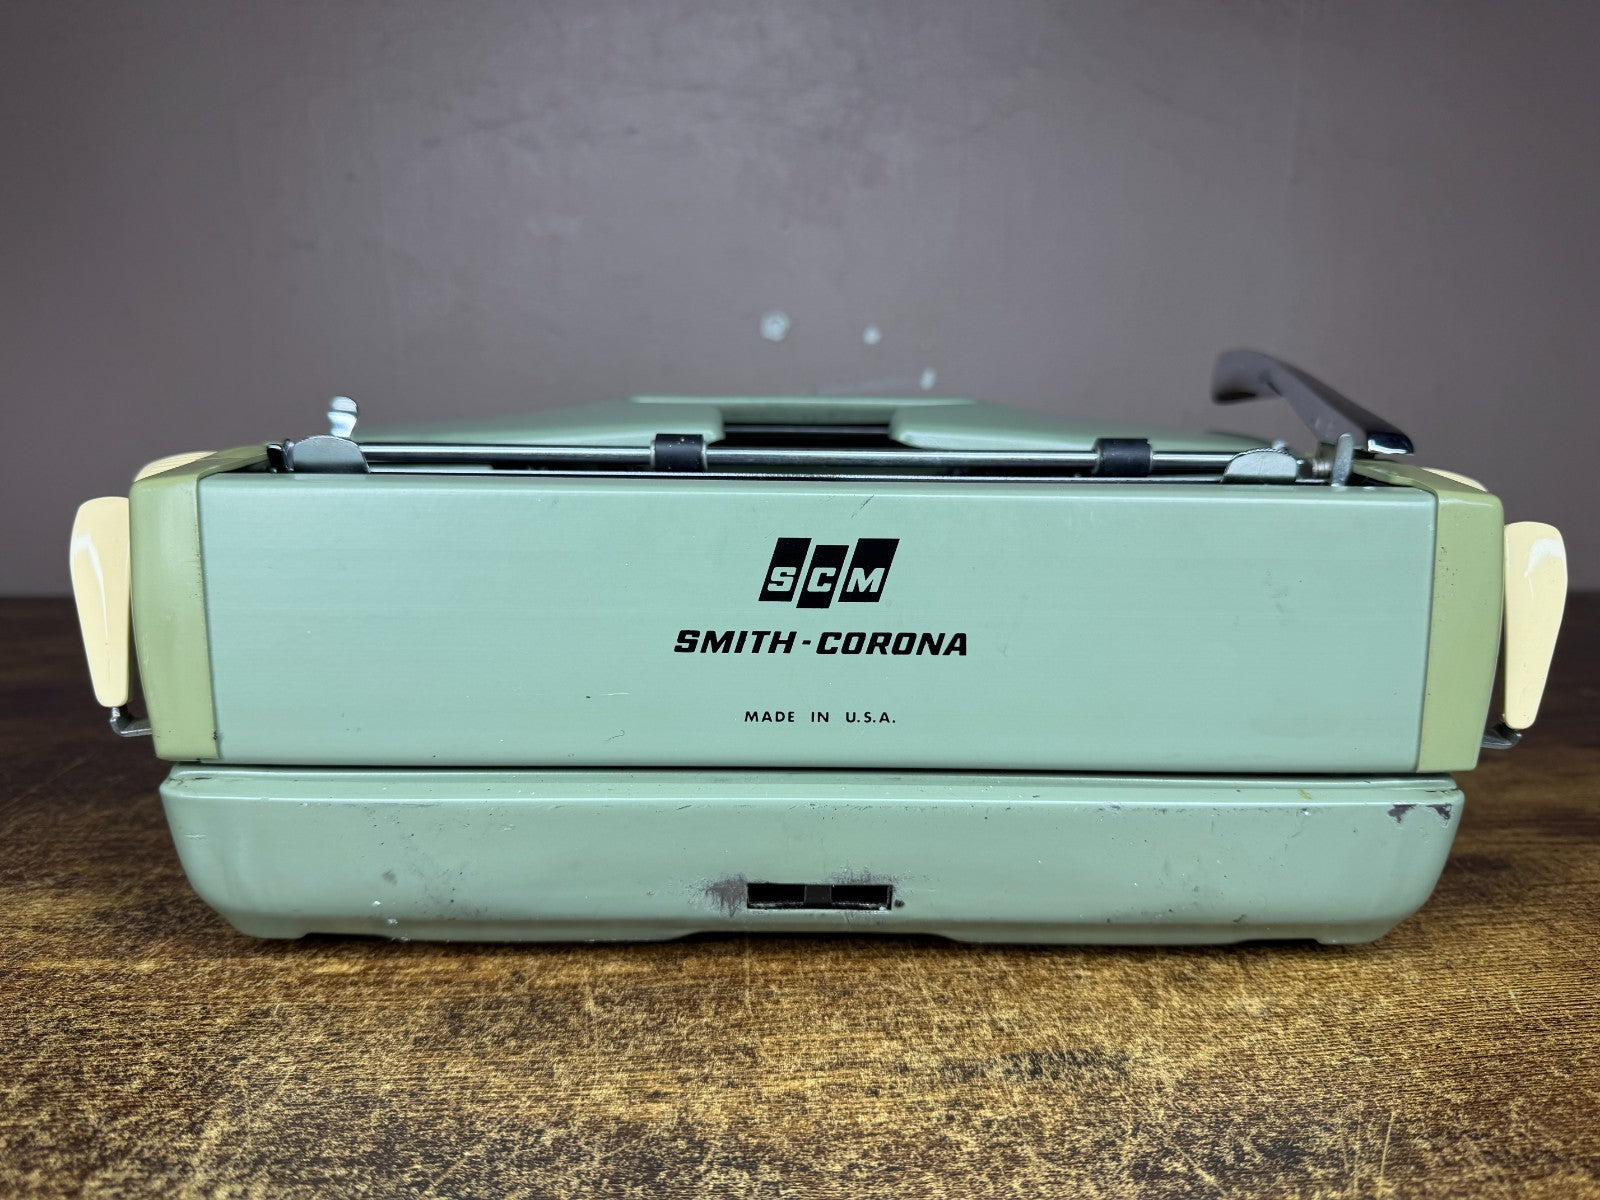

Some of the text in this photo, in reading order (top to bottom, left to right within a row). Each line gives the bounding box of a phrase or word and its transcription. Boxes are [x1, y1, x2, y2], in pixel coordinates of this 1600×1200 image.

[766, 566, 886, 593] SCM
[673, 629, 967, 656] SMITH-CORONA
[744, 710, 897, 724] MADE IN U.S.A.
